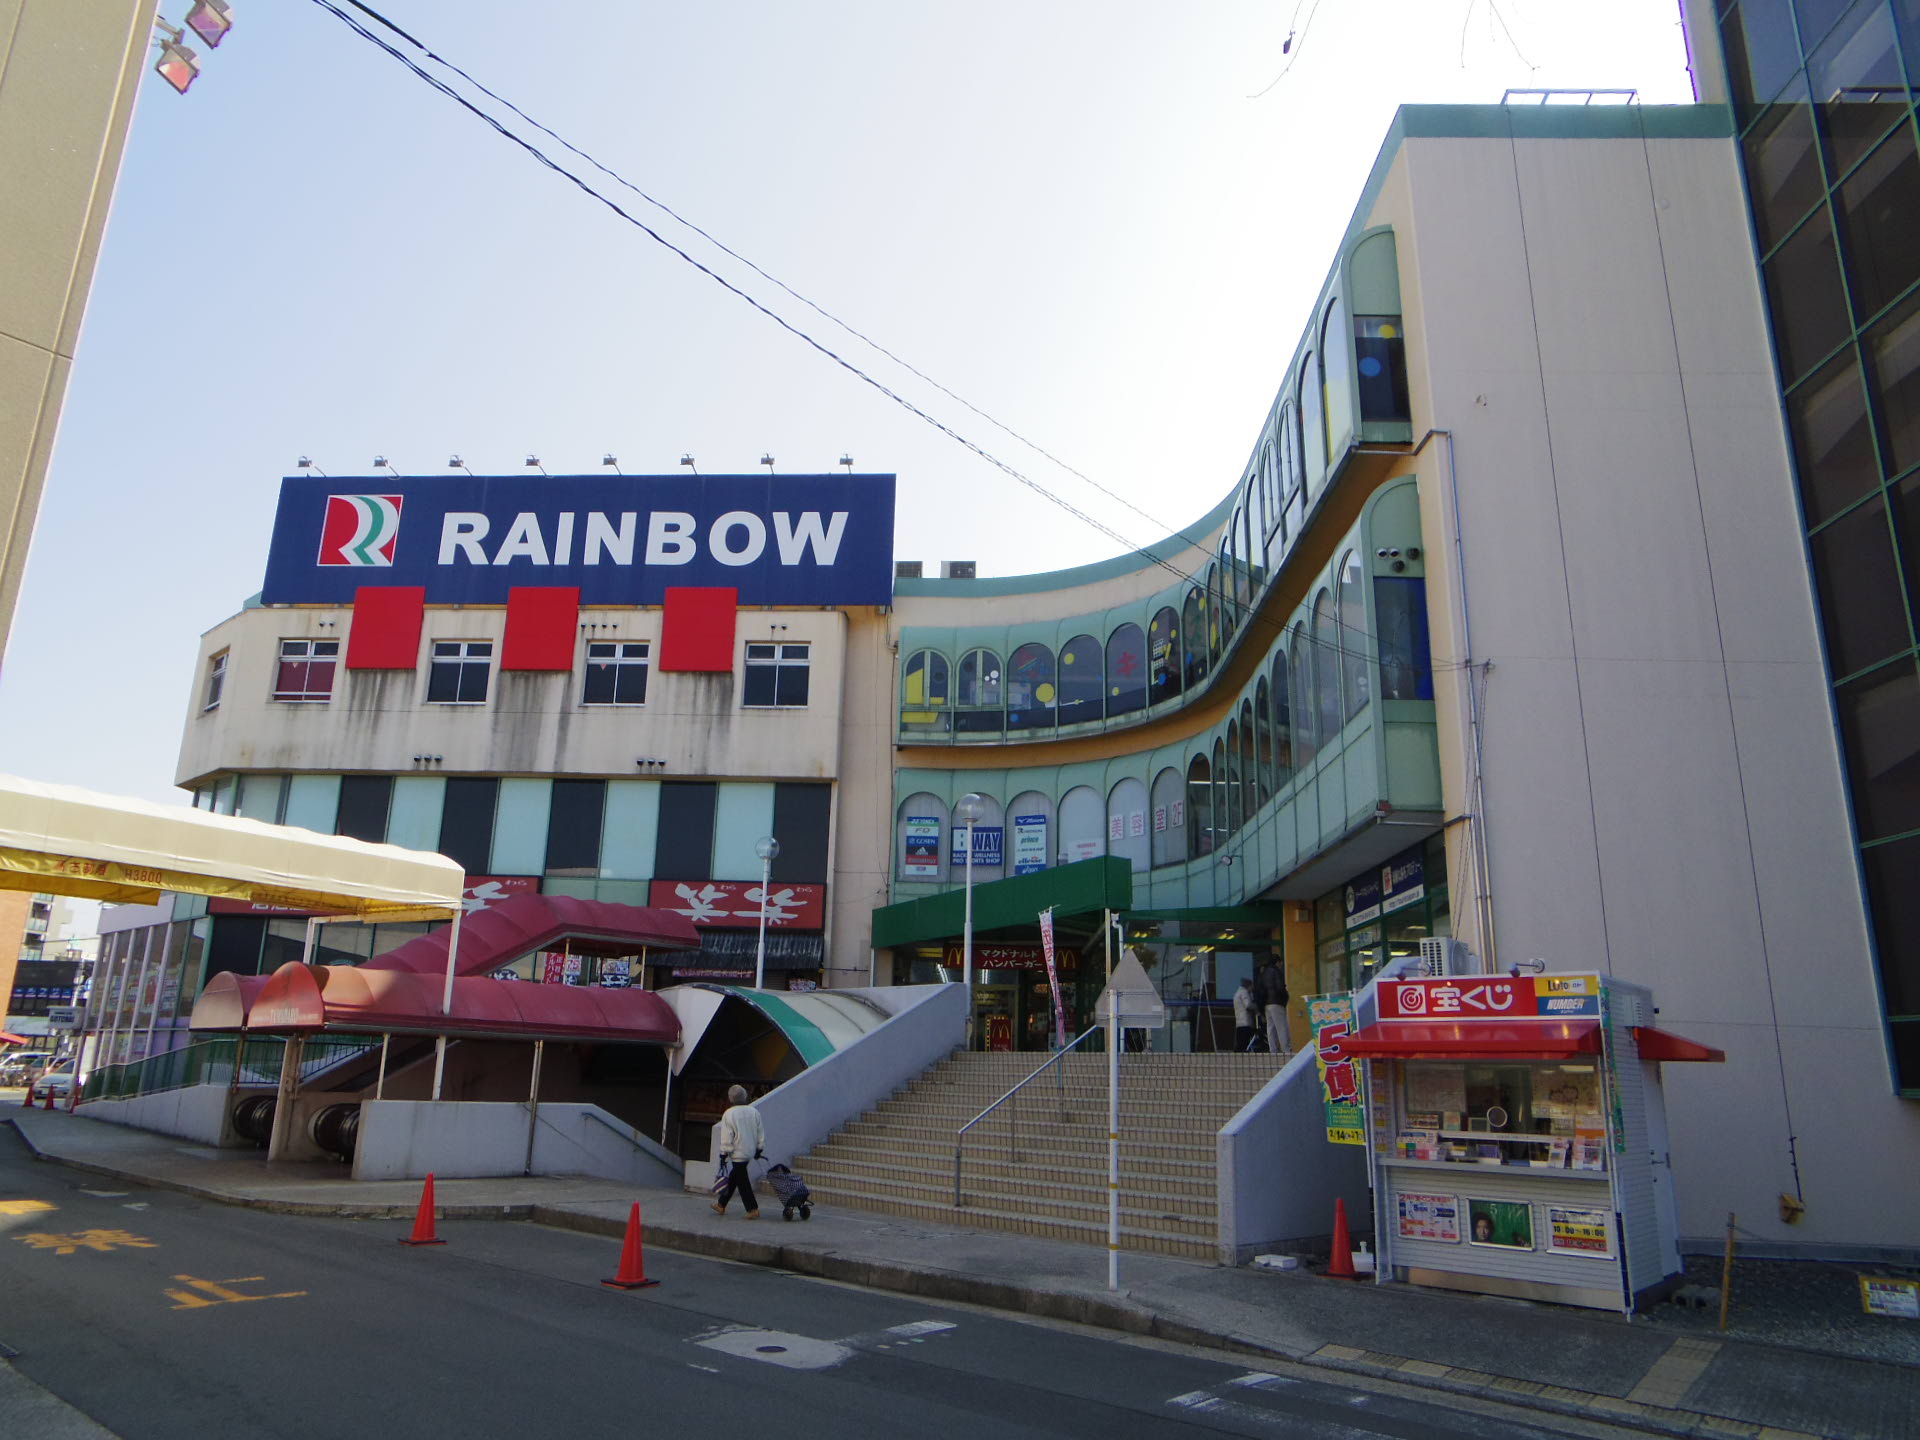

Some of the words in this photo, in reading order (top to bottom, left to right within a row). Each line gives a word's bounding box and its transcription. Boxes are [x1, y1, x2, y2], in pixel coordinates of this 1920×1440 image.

[437, 510, 849, 566] RAINBOW
[971, 832, 1001, 851] WAY
[980, 949, 1040, 959] マクドナルド
[982, 959, 1043, 968] ハンバーガー
[1430, 983, 1514, 1012] 宝くじ
